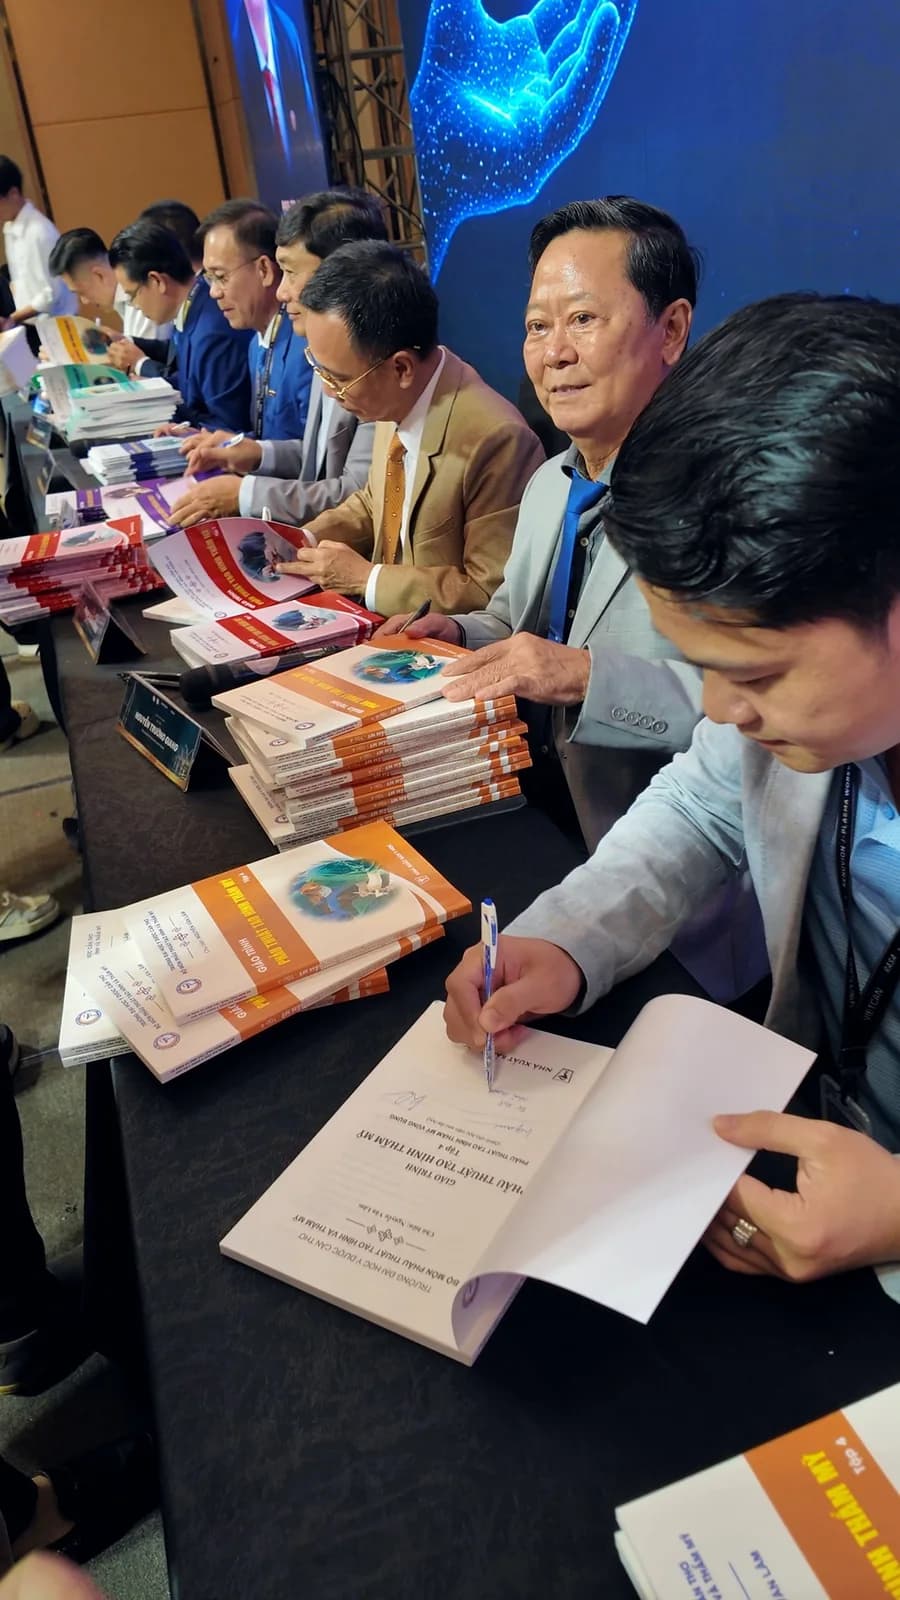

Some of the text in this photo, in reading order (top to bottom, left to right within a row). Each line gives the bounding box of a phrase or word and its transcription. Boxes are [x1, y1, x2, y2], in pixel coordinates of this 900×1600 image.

[238, 937, 267, 972] GIÁO TRÌNH
[507, 1056, 531, 1066] XUẤT
[533, 1063, 552, 1072] NHÀ
[356, 1129, 374, 1140] MỸ
[374, 1135, 404, 1152] THẨM
[444, 1144, 459, 1156] Tập
[406, 1147, 434, 1163] HÌNH
[435, 1158, 456, 1171] TẠO
[404, 1162, 455, 1185] GIÁO TRÌNH
[457, 1167, 494, 1184] THUẬT
[835, 1436, 866, 1475] Tập 4
[802, 1450, 839, 1485] MỸ
[825, 1483, 879, 1547] THẨM
[678, 1532, 696, 1551] MỸ
[690, 1550, 717, 1586] THẨM
[749, 1549, 787, 1600] ĂN LÂM
[691, 1584, 707, 1600] ẦN
